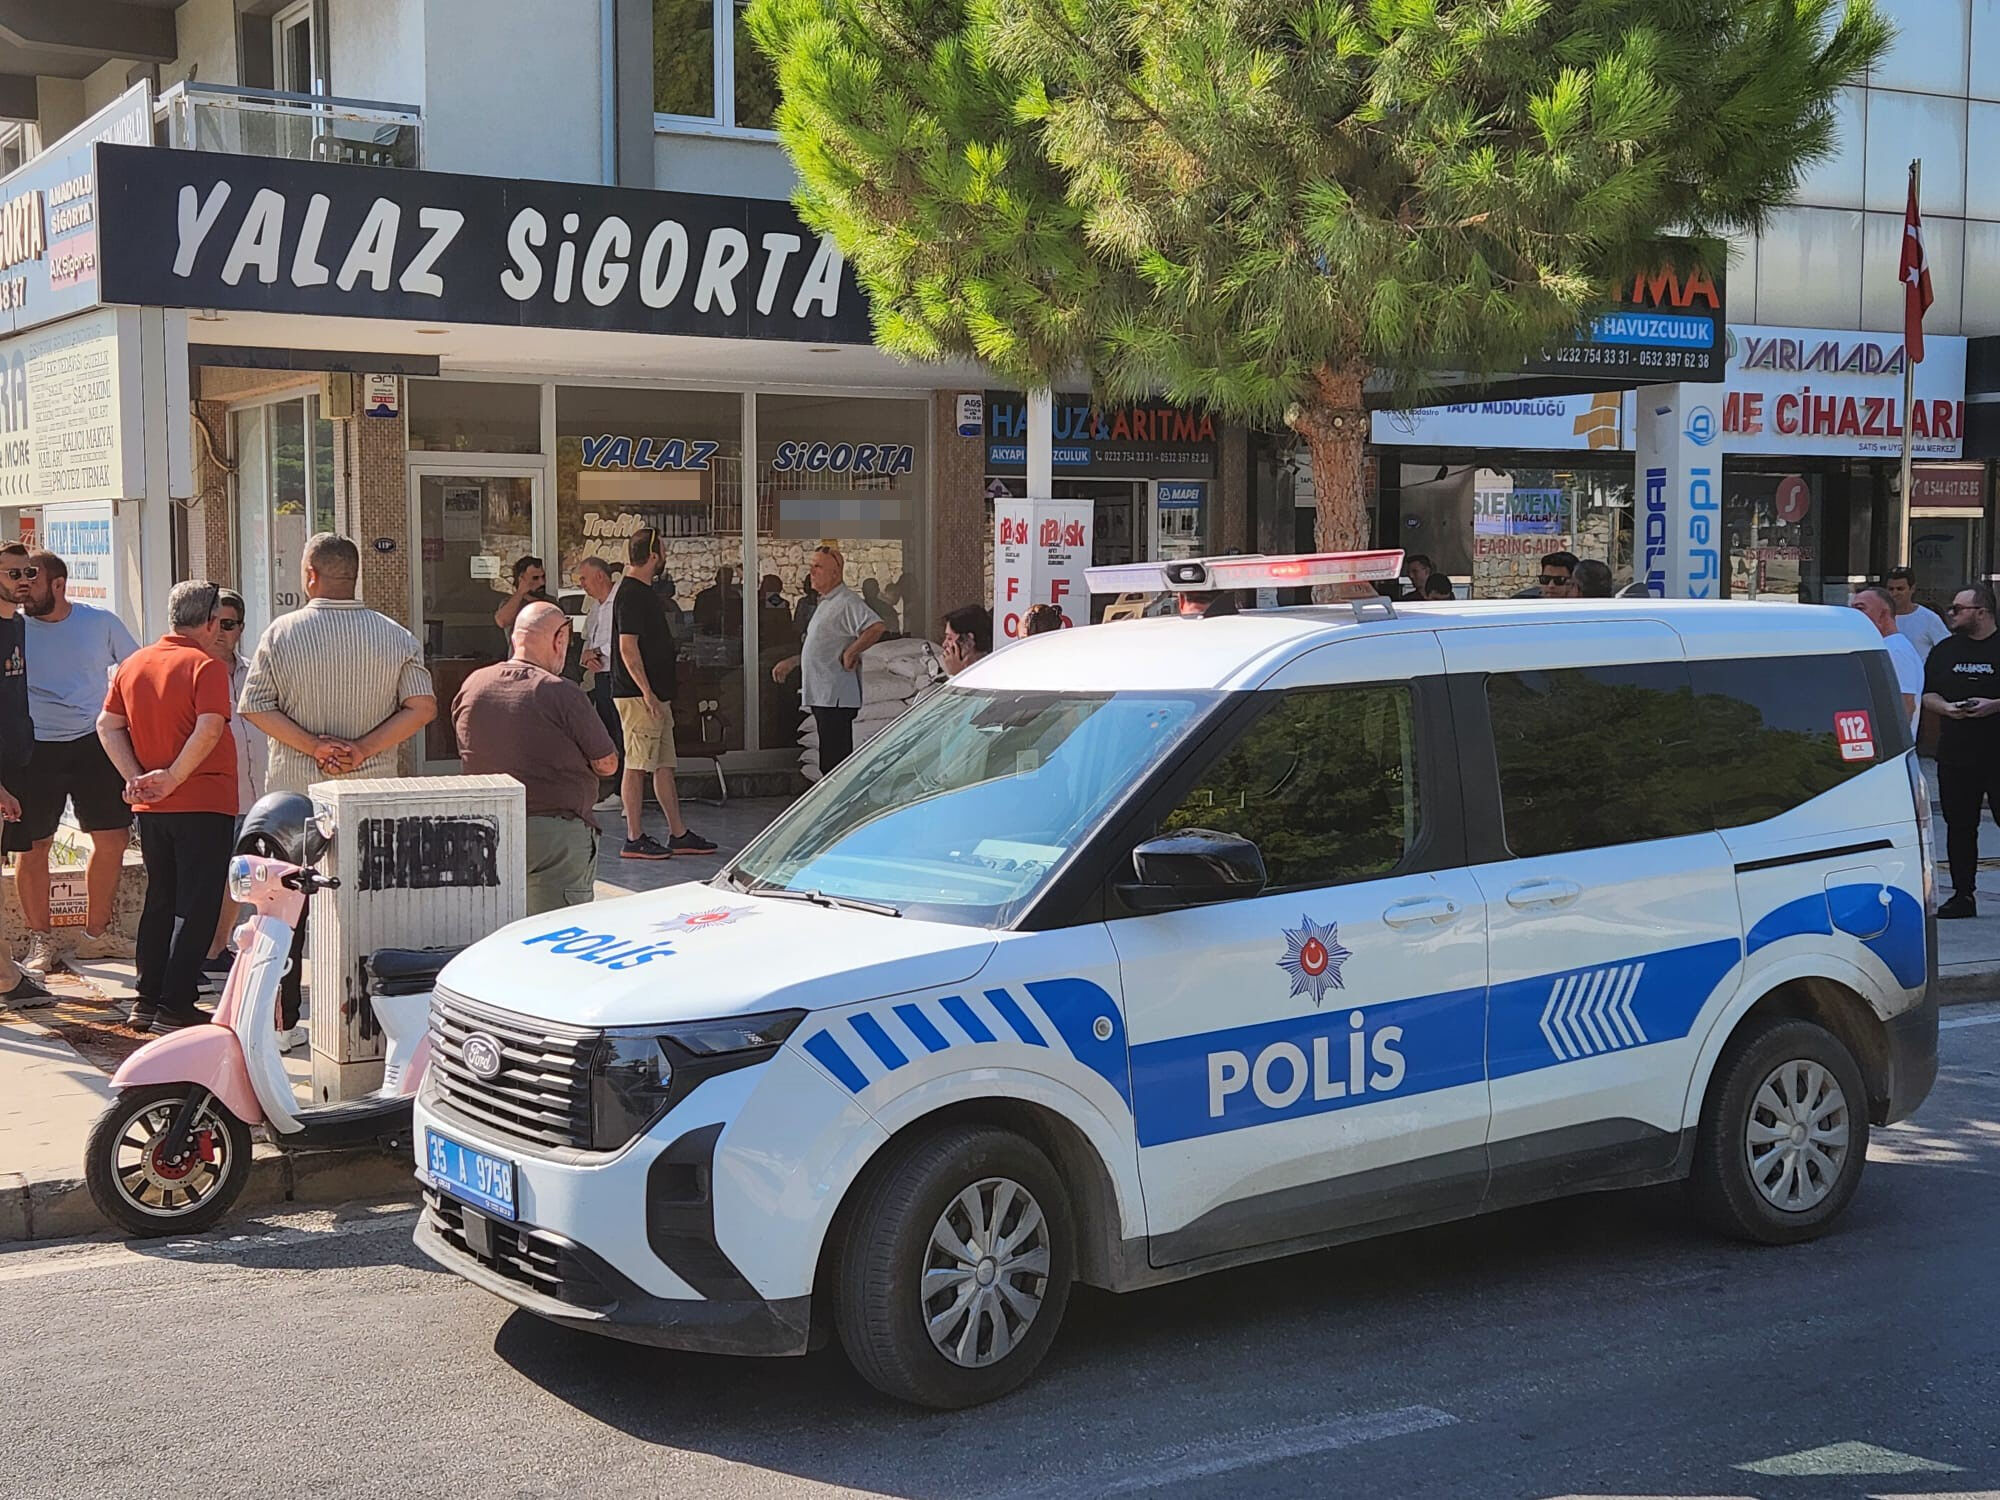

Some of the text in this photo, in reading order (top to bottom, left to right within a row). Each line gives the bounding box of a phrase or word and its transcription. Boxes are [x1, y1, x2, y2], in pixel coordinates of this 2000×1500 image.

[0, 189, 44, 269] ORTA
[172, 179, 466, 298] YALAZ
[1603, 317, 1710, 341] HAVUZCULUK
[1584, 348, 1601, 364] 754
[1604, 348, 1616, 365] 33
[1618, 349, 1630, 366] 31
[1640, 350, 1663, 367] 0532
[1665, 352, 1682, 368] 397
[1684, 353, 1696, 369] 62
[1698, 353, 1710, 370] 38
[581, 433, 720, 471] YALAZ
[1171, 488, 1200, 500] MAPEI
[1840, 715, 1868, 741] 112
[520, 926, 677, 970] POLİS
[468, 1042, 492, 1071] Ford
[1207, 1009, 1406, 1118] POLİS
[429, 1134, 448, 1174] 35
[458, 1147, 467, 1185] A
